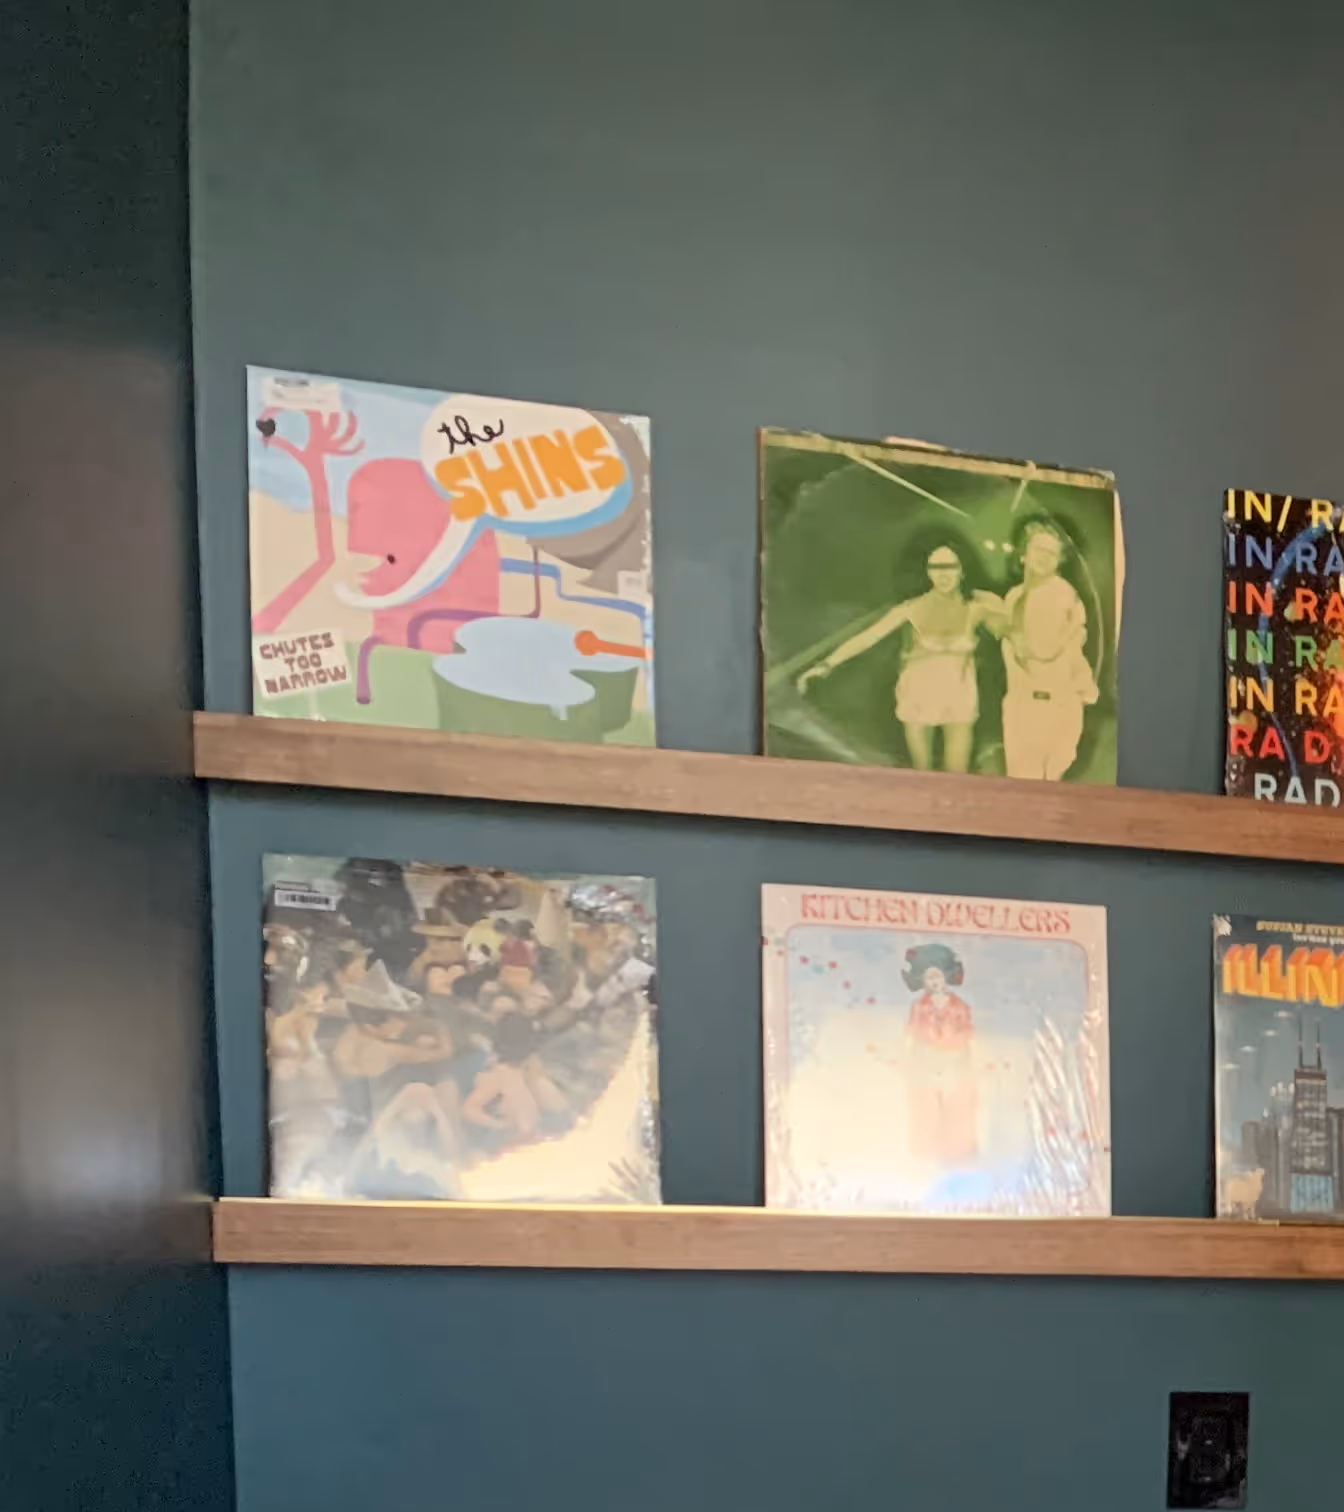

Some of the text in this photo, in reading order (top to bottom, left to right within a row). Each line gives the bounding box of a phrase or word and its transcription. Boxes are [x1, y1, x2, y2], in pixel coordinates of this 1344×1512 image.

[438, 415, 504, 454] the
[434, 425, 626, 522] SHINS
[1226, 533, 1273, 571] IN
[1226, 580, 1274, 618] IN
[259, 631, 336, 661] CHUTES
[284, 652, 323, 671] TOO
[1226, 629, 1274, 665] IN
[264, 664, 348, 694] NARROW
[1228, 675, 1275, 713] IN
[801, 893, 1071, 934] KITCHEN DWELLERS
